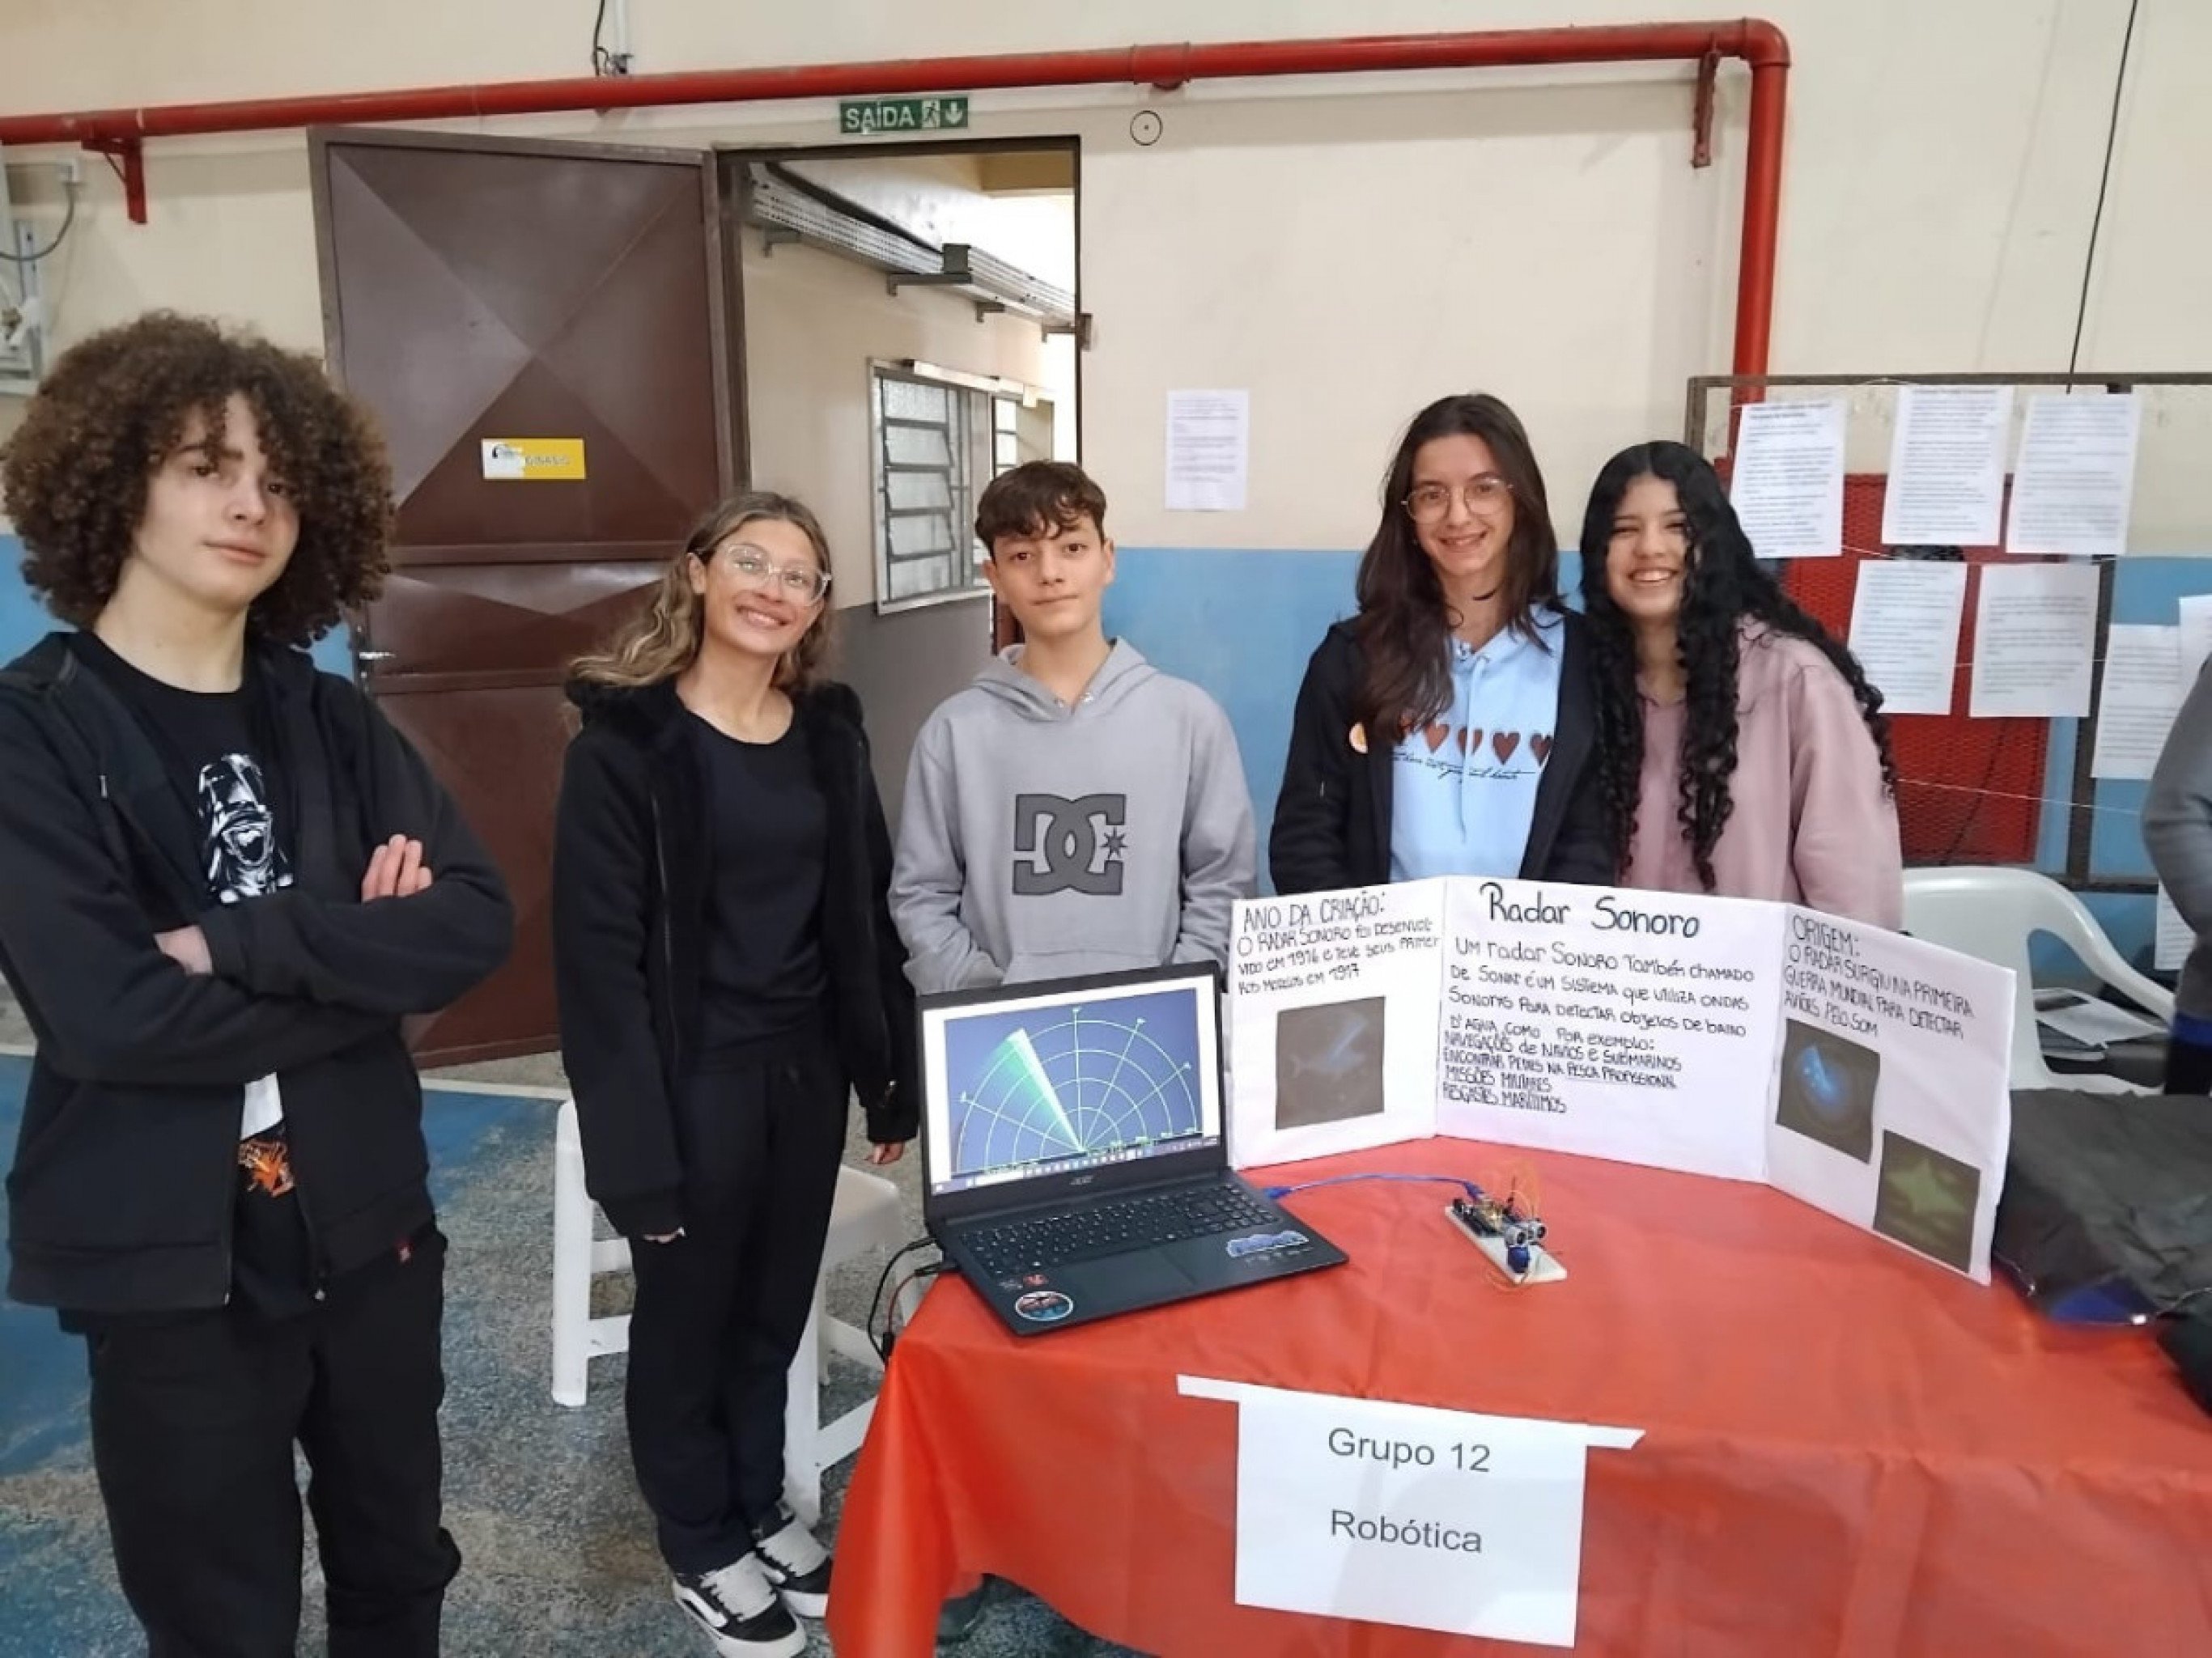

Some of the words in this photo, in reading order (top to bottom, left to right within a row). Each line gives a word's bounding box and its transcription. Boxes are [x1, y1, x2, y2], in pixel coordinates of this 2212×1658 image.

[1244, 906, 1281, 933] ANO
[1289, 904, 1312, 931] DA
[1480, 881, 1571, 924] Radar
[1591, 895, 1700, 939] Sonoro
[1237, 935, 1254, 956] O
[1793, 914, 1861, 957] ORIGEM:
[1328, 1427, 1436, 1469] Grupo
[1451, 1443, 1491, 1473] 12
[1331, 1509, 1482, 1553] Robótica
